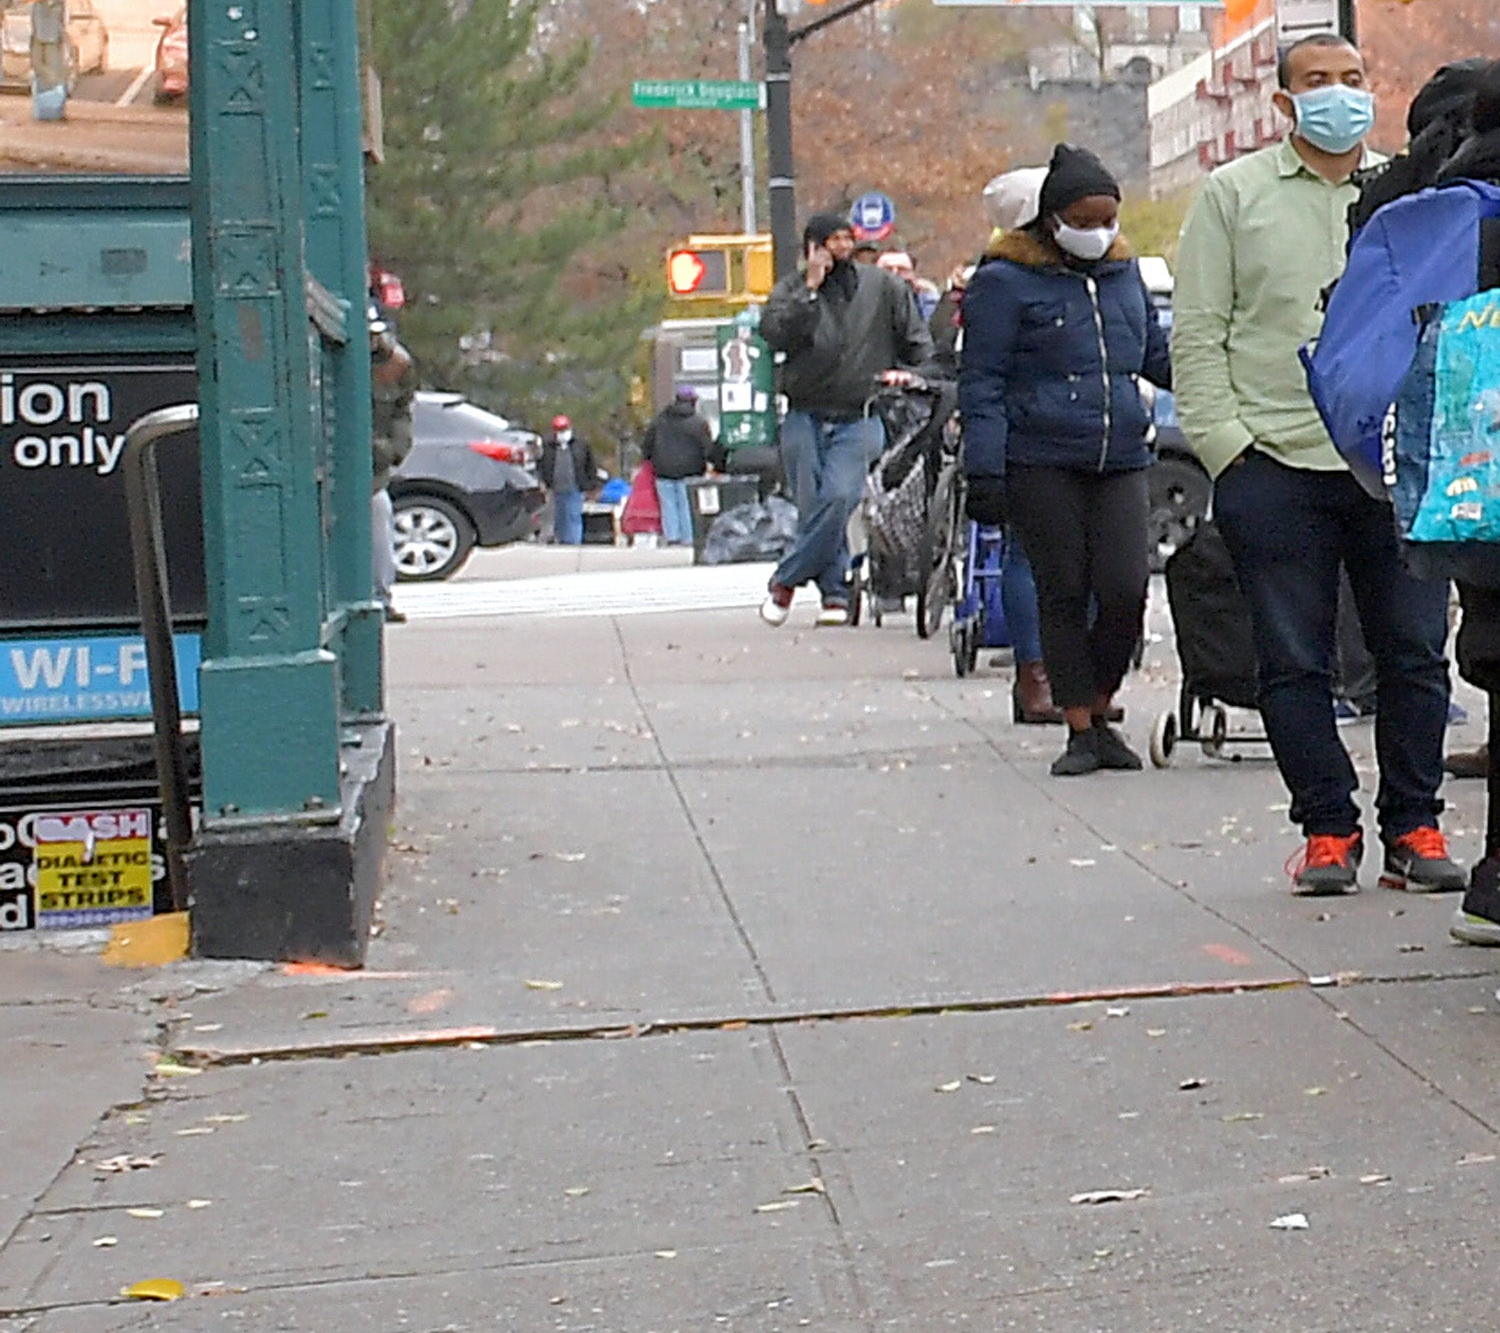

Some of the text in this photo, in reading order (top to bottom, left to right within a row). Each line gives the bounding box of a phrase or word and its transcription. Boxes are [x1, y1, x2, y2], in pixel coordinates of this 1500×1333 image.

[14, 426, 126, 475] only
[10, 644, 147, 690] WI-F
[58, 871, 124, 887] TEST
[40, 888, 145, 909] STRIPS
